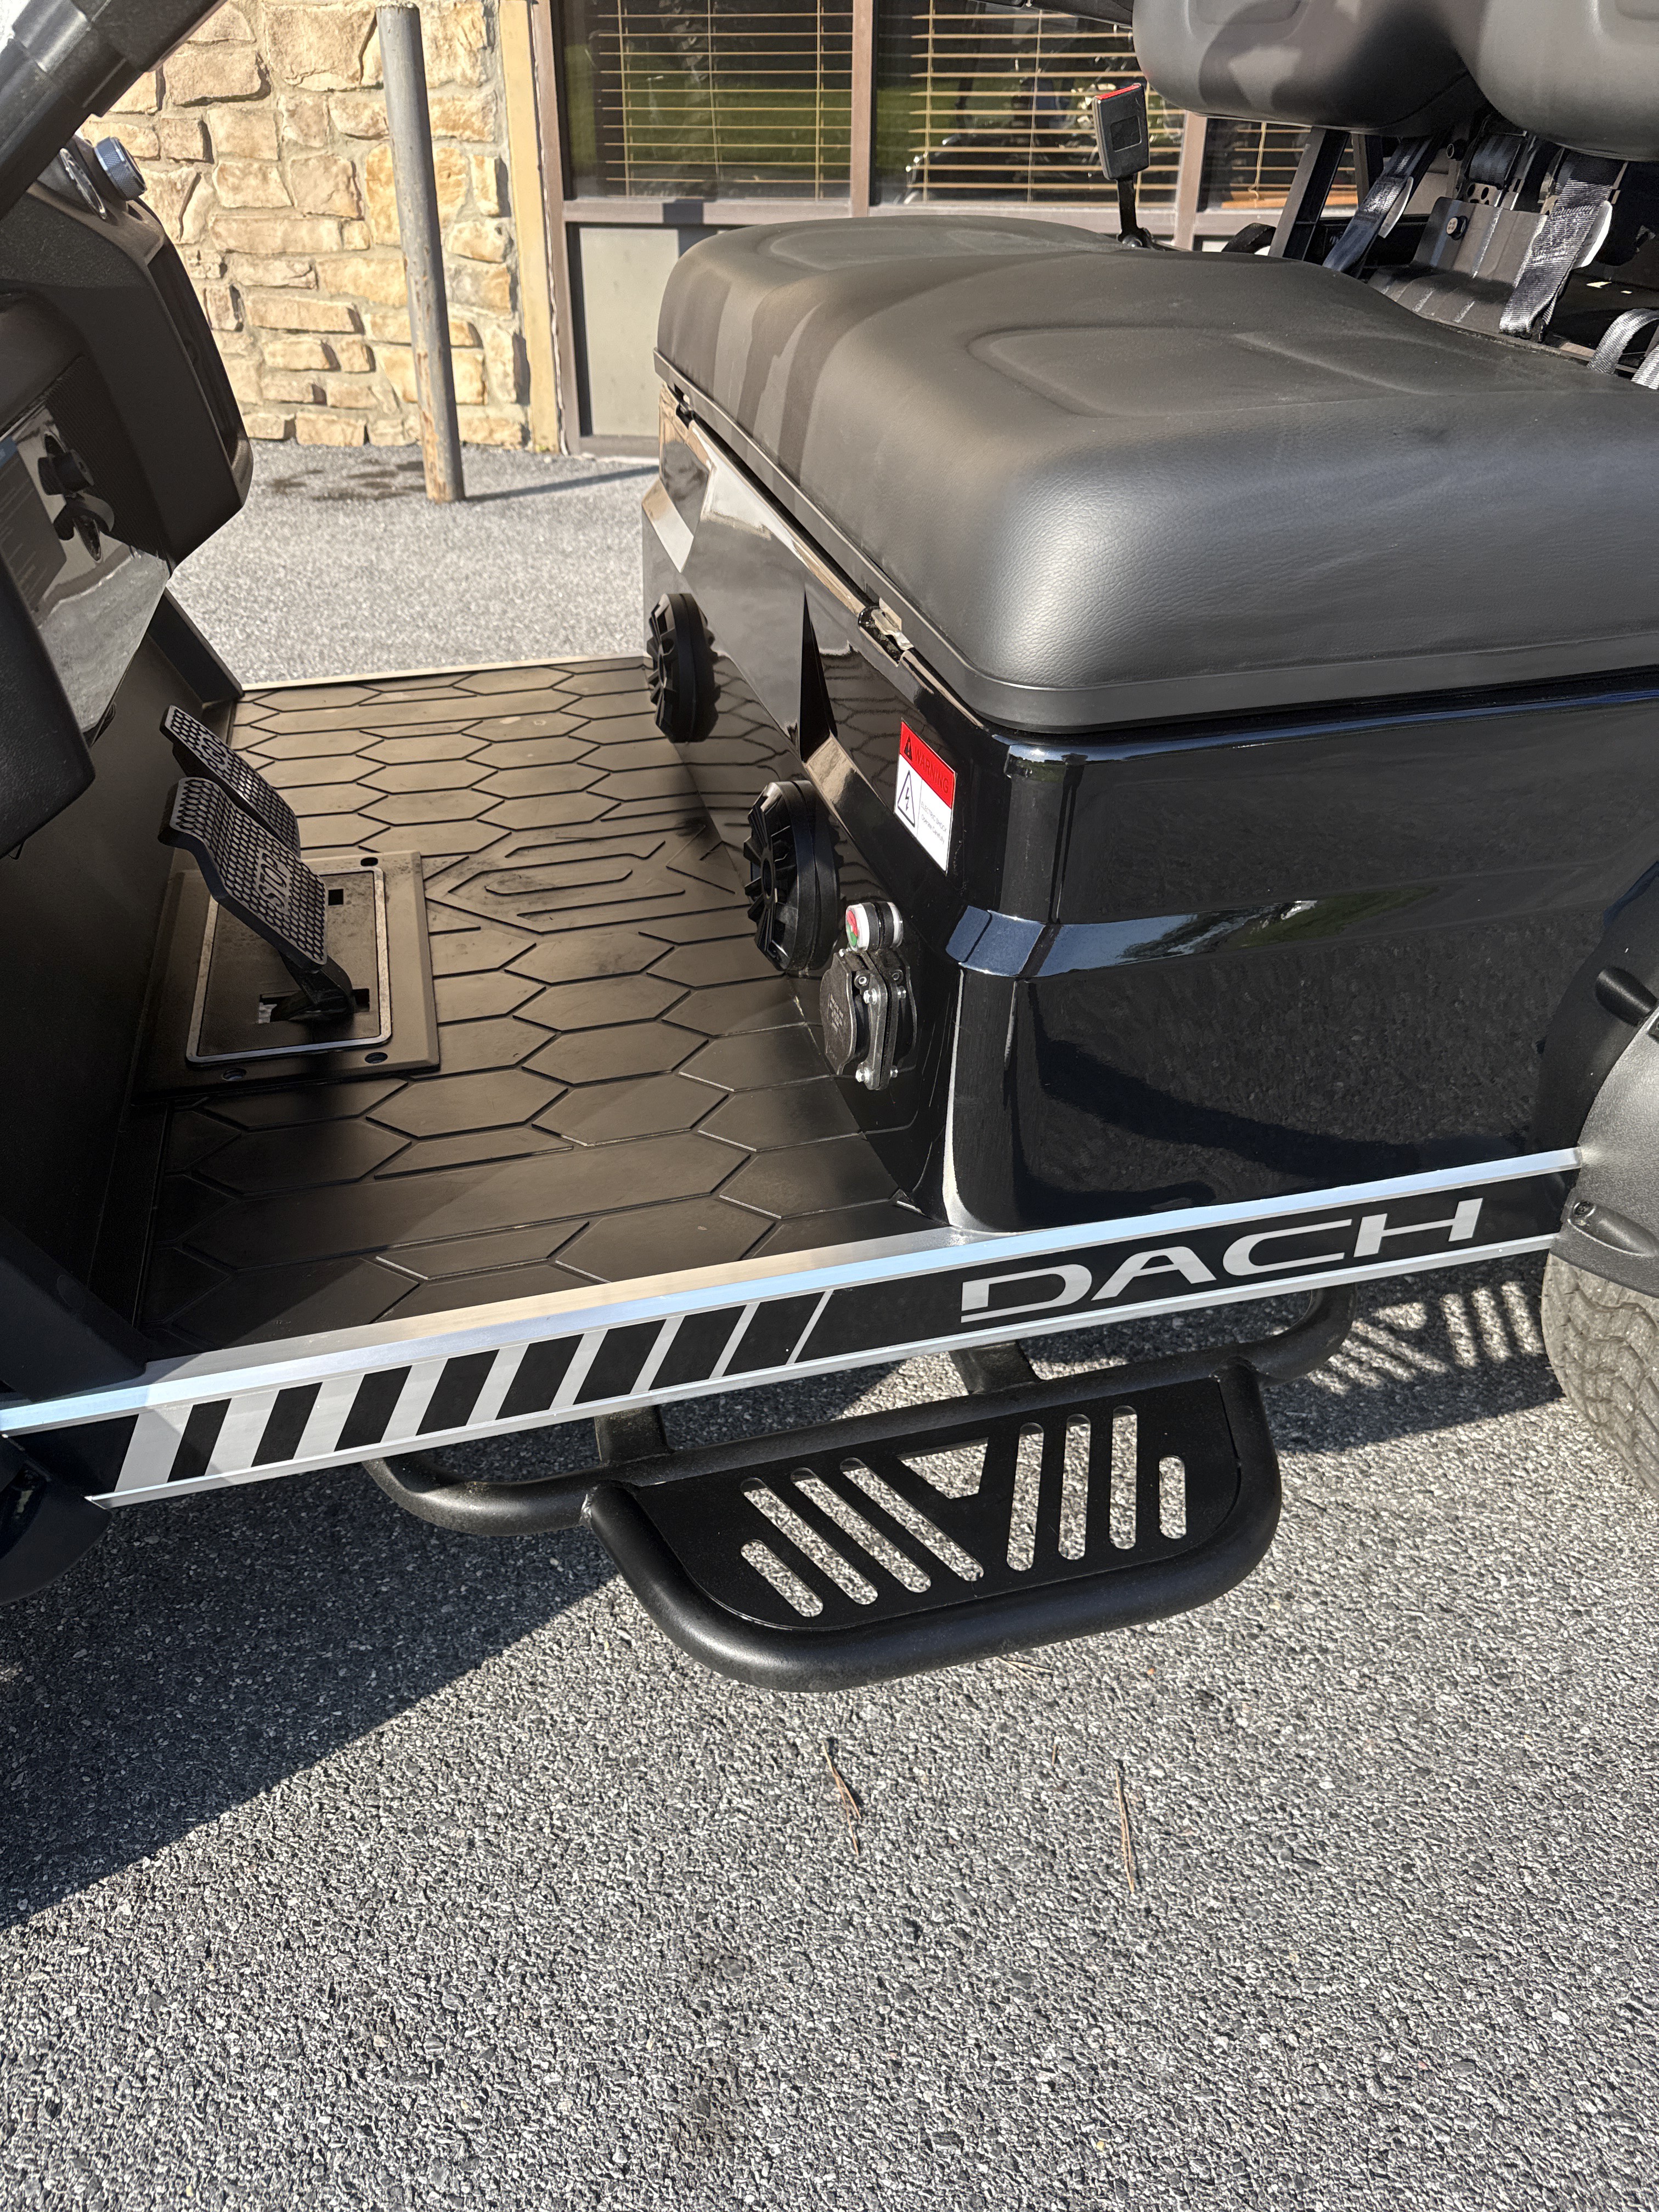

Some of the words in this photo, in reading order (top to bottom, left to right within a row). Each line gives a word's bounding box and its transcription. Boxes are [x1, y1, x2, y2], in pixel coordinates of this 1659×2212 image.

[915, 747, 949, 793] WARNING
[258, 852, 287, 909] STOP
[961, 1198, 1483, 1323] DACH
